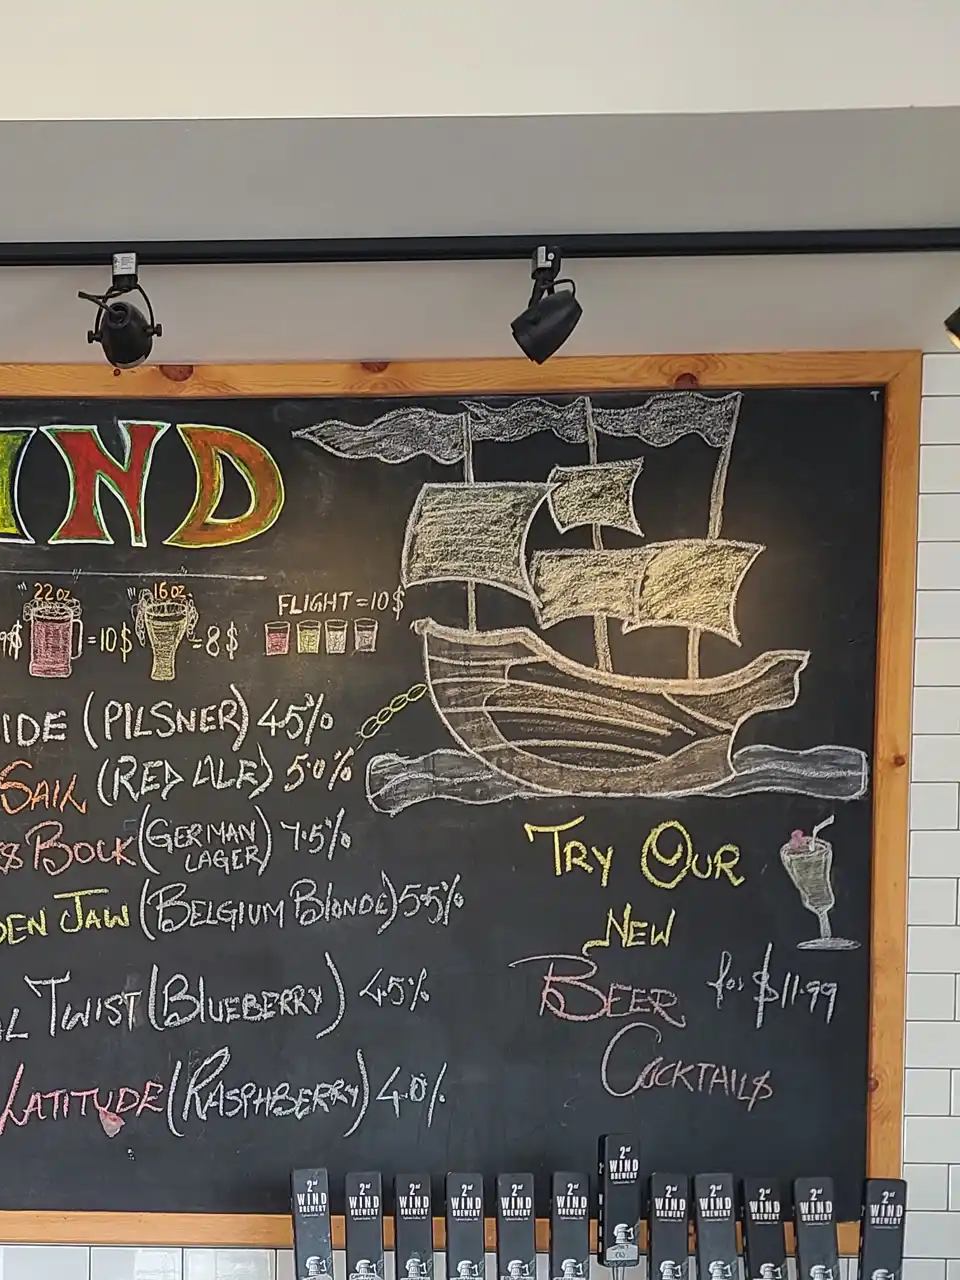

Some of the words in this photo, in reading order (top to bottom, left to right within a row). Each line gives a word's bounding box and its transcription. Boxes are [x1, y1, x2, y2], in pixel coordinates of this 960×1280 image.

[277, 591, 353, 616] FLIGHT
[84, 683, 250, 751] (PILSNER)
[97, 754, 185, 807] (RED
[24, 820, 138, 877] BOCK
[524, 815, 614, 888] TRY
[640, 820, 747, 890] OUR
[53, 888, 130, 933] JAW
[139, 878, 285, 941] (BELGIUM
[581, 902, 676, 956] NEW
[508, 953, 687, 1028] BEER
[24, 970, 143, 1037] TWIST
[609, 1159, 639, 1172] WIND
[610, 1172, 638, 1180] BREWERY
[296, 1192, 327, 1206] WIND
[348, 1195, 380, 1209] WIND
[399, 1195, 430, 1208] WIND
[450, 1197, 482, 1210] WIND
[500, 1197, 532, 1210] WIND
[556, 1195, 588, 1209] WIND
[654, 1197, 687, 1211] WIND
[699, 1197, 732, 1210] WIND
[298, 1204, 327, 1213] BREWERY
[350, 1208, 378, 1216] BREWERY
[400, 1208, 428, 1216] BREWERY
[452, 1209, 481, 1217] BREWERY
[502, 1209, 531, 1217] BREWERY
[557, 1208, 587, 1216] BREWERY
[701, 1209, 731, 1217] BREWERY
[749, 1200, 781, 1213] WIND
[799, 1200, 833, 1214] WIND
[869, 1204, 903, 1217] WIND
[656, 1209, 685, 1218] BREWERY
[751, 1213, 780, 1221] BREWERY
[801, 1213, 832, 1222] BREWERY
[871, 1216, 902, 1225] BREWERY
